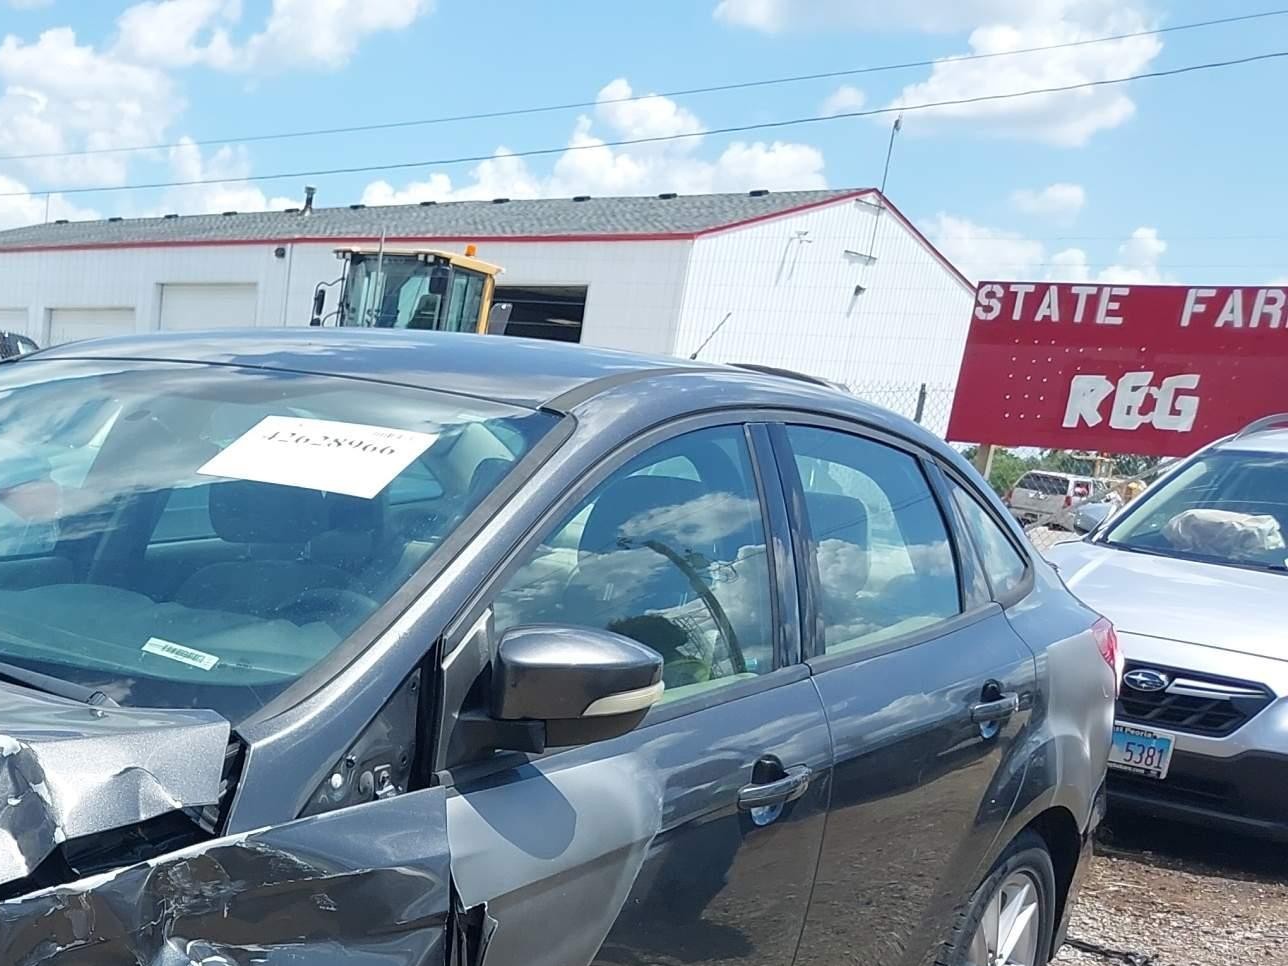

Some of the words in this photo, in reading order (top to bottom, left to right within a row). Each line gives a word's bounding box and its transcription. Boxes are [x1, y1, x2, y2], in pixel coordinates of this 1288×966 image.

[975, 284, 1130, 326] STATE
[1180, 288, 1288, 329] FAR
[1123, 741, 1164, 770] 5381
